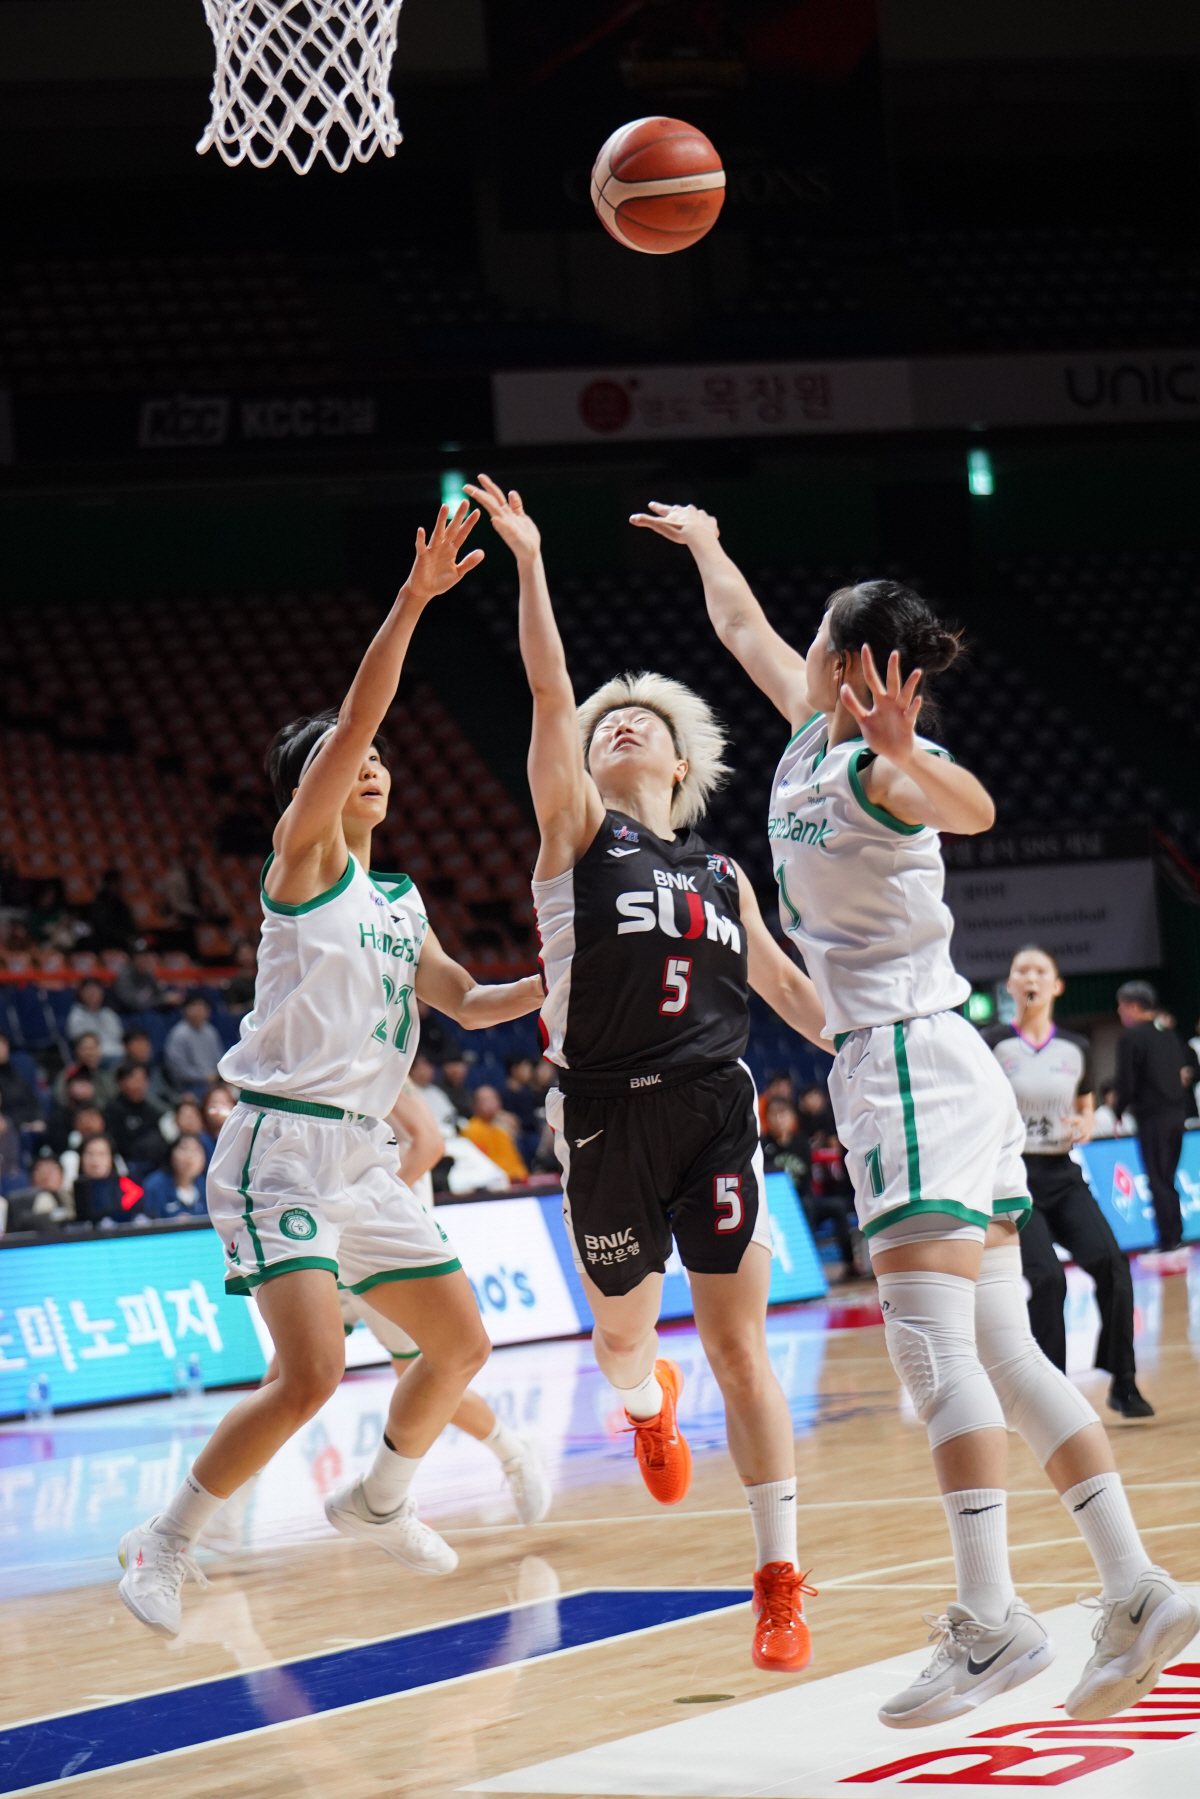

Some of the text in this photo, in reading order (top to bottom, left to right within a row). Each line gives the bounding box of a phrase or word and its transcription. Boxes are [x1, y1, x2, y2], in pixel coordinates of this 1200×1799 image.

[240, 396, 377, 440] KCC건설
[700, 371, 834, 424] 목장원
[768, 811, 833, 848] anaBank
[652, 869, 699, 893] BNK
[615, 887, 741, 955] SUM
[659, 956, 692, 1016] 5
[371, 974, 414, 1054] 21
[629, 1073, 662, 1089] BNK
[864, 1143, 886, 1198] 1
[713, 1174, 745, 1235] 5
[584, 1227, 636, 1251] BNK
[586, 1241, 641, 1266] 부산은행
